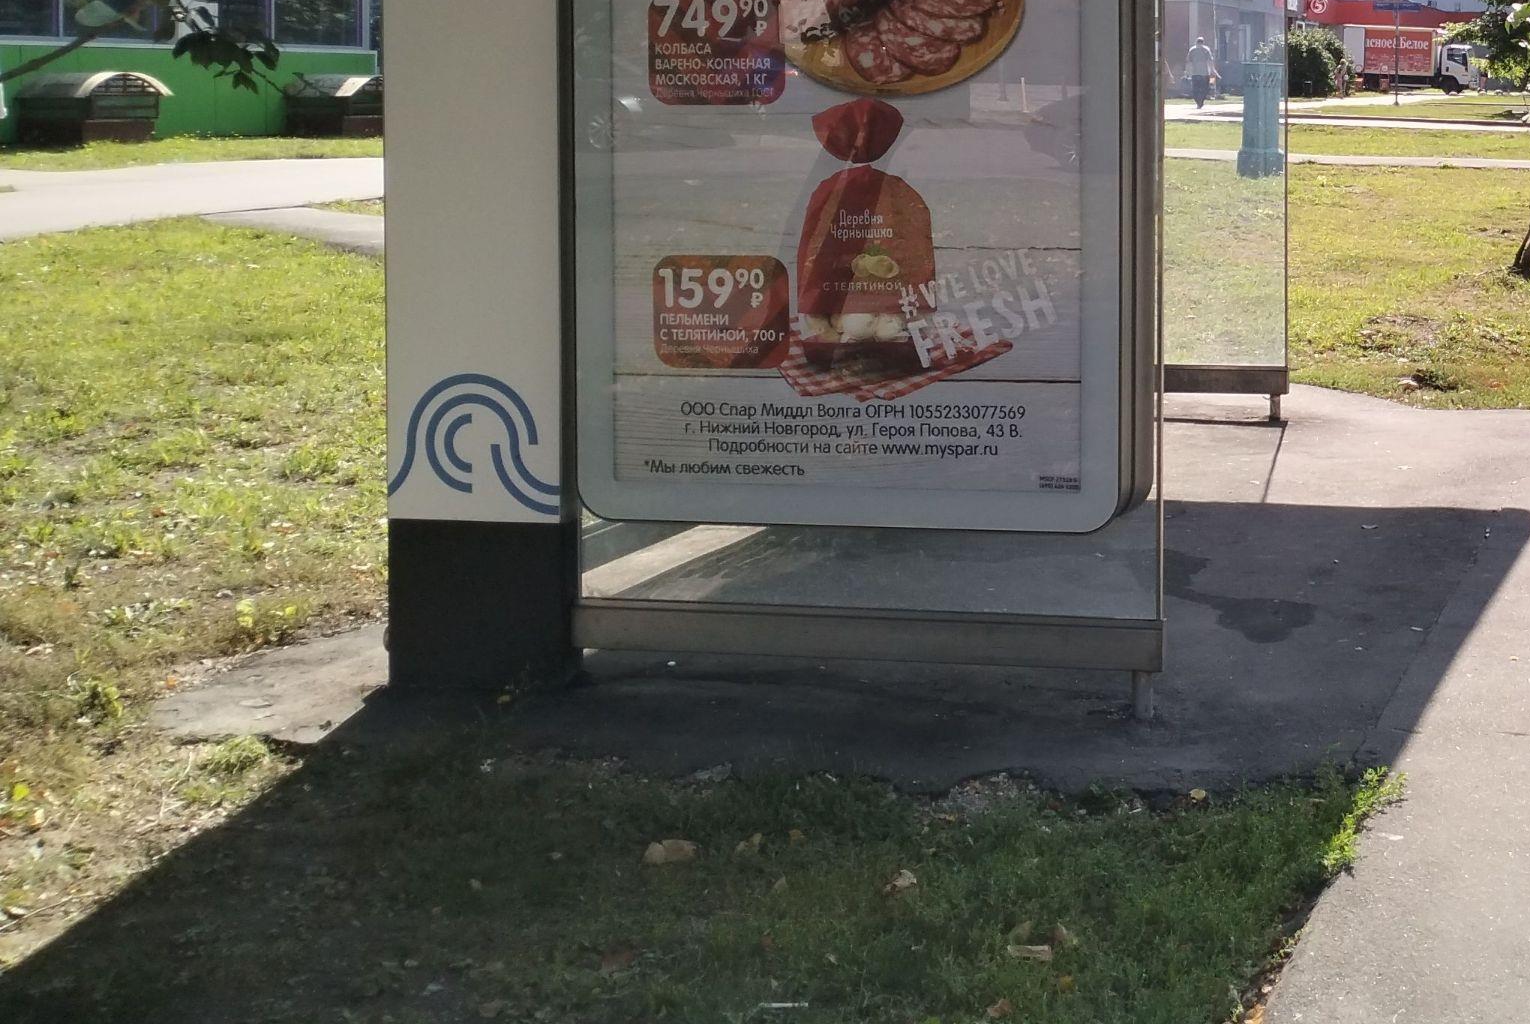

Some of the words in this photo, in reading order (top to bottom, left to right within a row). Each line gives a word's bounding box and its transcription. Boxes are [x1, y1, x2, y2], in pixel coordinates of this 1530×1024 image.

[654, 42, 713, 56] КОЛБАСА
[654, 57, 772, 71] ВАРЕНО-КОПЧЕНАЯ
[655, 72, 742, 87] МОСКОВСКАЯ,
[745, 73, 751, 85] 1
[839, 208, 884, 228] Деревня
[830, 223, 894, 242] Чернышиха
[968, 248, 1037, 293] LOVE
[658, 268, 735, 309] 159
[735, 268, 765, 289] 90
[659, 313, 729, 326] ПЕЛЬМЕНИ
[906, 277, 1058, 369] FRESH
[660, 328, 669, 341] С
[671, 326, 750, 343] ТЕЛЯТИНОЙ,
[753, 329, 776, 342] 700
[778, 331, 786, 342] г
[681, 401, 715, 416] ООО
[719, 402, 757, 420] Спар
[760, 402, 813, 420] Миддл
[817, 403, 861, 419] Волга
[865, 404, 905, 419] ОГРН
[909, 404, 1026, 420] 1055233077569
[684, 423, 696, 435] г.
[699, 420, 760, 436] Нижний
[764, 421, 842, 439] Новгород,
[847, 424, 868, 439] ул.
[872, 422, 916, 440] Героя
[920, 423, 981, 440] Попова,
[986, 424, 1005, 438] 43
[1009, 424, 1023, 439] В.
[708, 438, 809, 455] Подробности
[813, 442, 831, 455] на
[835, 440, 878, 456] сайте
[882, 442, 999, 459] www.myspar.ru
[679, 460, 732, 475] любим
[735, 463, 805, 477] свежесть
